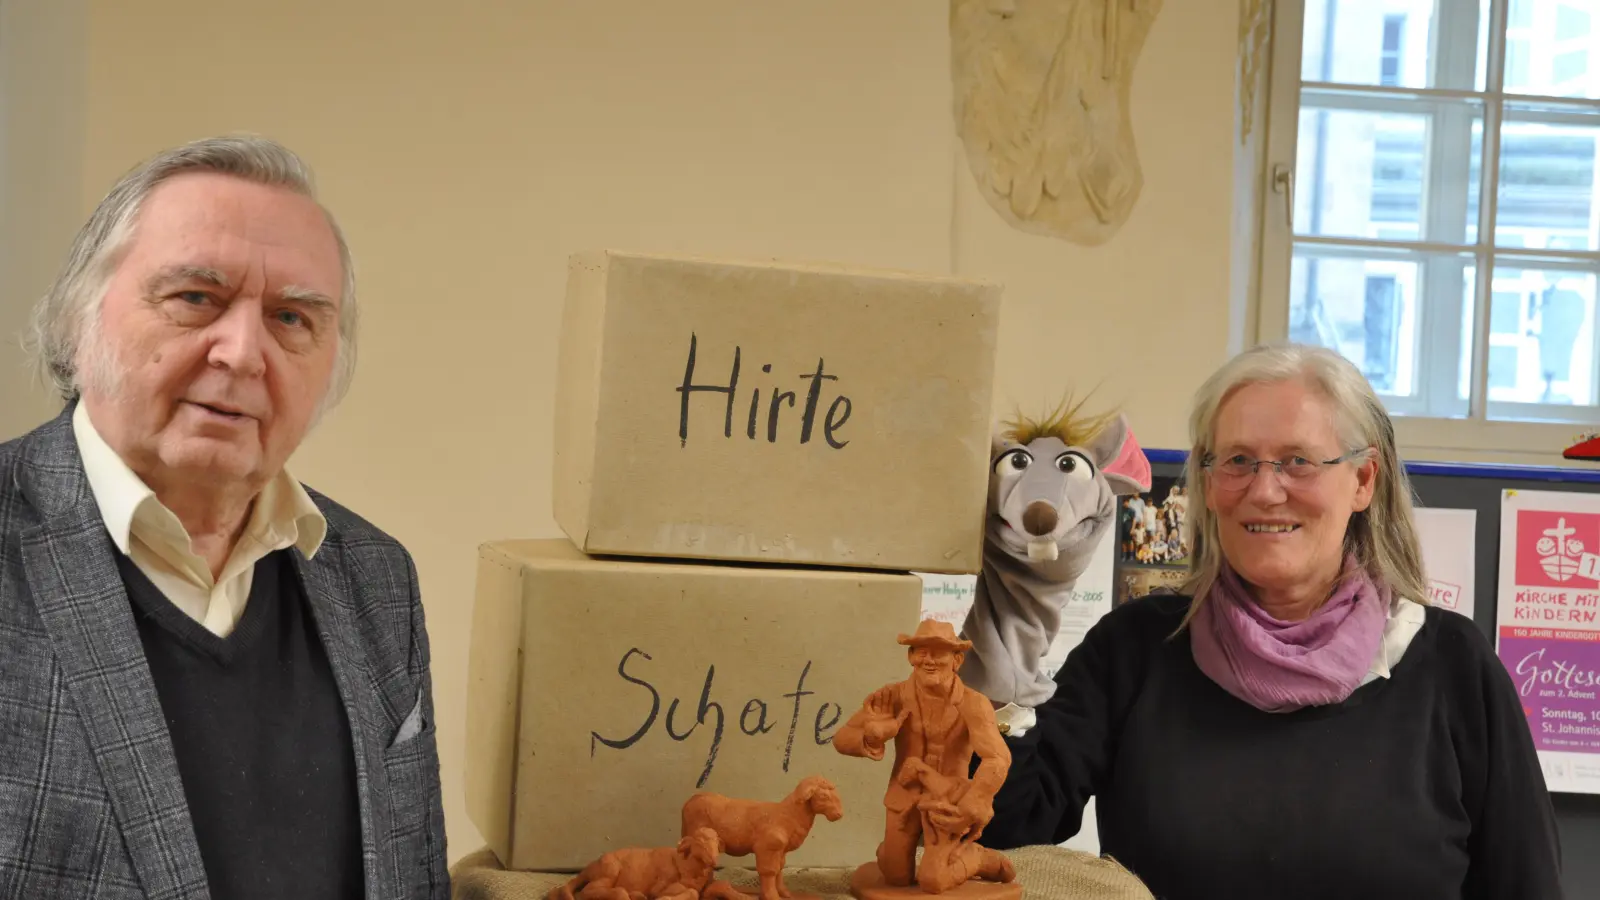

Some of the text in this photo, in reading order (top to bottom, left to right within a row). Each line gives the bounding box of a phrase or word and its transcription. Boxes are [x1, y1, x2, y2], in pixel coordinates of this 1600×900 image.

[676, 331, 852, 449] Hirte
[1568, 690, 1596, 700] Advent
[1542, 707, 1587, 722] Sonntag,
[1542, 722, 1555, 733] St.
